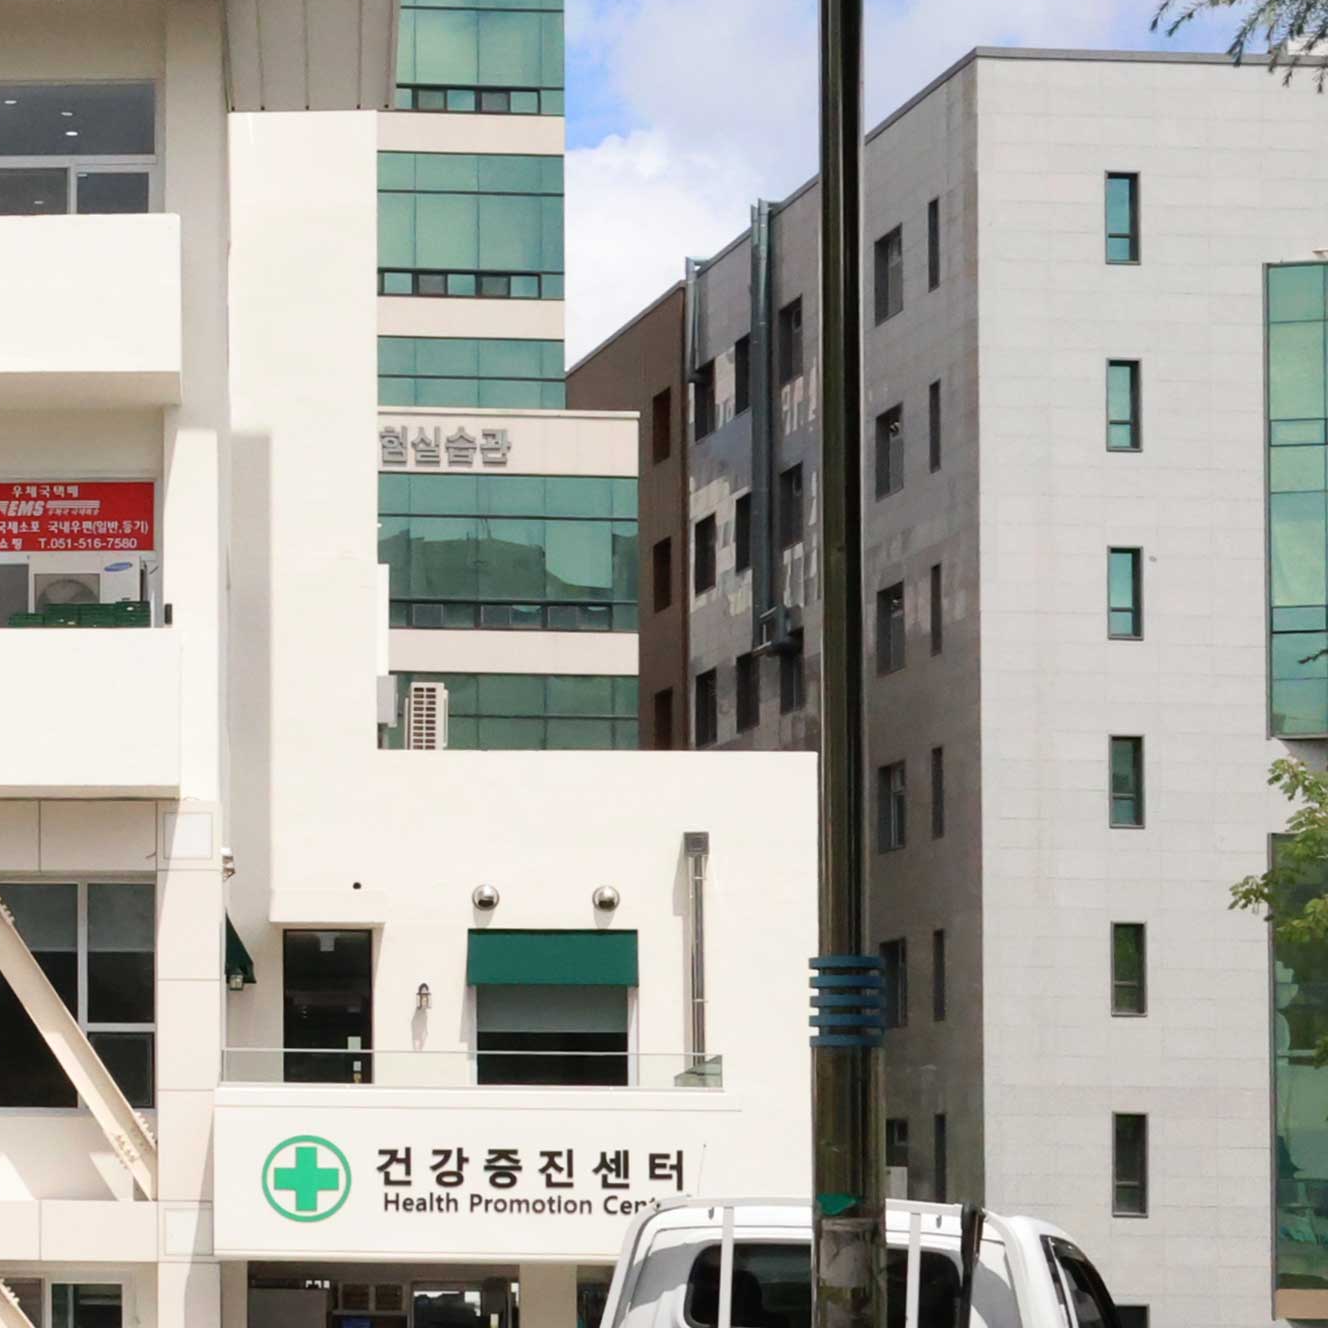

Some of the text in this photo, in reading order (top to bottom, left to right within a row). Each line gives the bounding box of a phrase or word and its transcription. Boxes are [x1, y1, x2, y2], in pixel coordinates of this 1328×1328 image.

[379, 426, 511, 464] 험실습관
[11, 485, 79, 498] 우체국택배
[6, 501, 45, 517] EMS
[38, 537, 138, 549] T.051-516-7580
[376, 1147, 684, 1191] 건강증진센터
[384, 1193, 459, 1213] Health
[469, 1194, 592, 1215] Promotion
